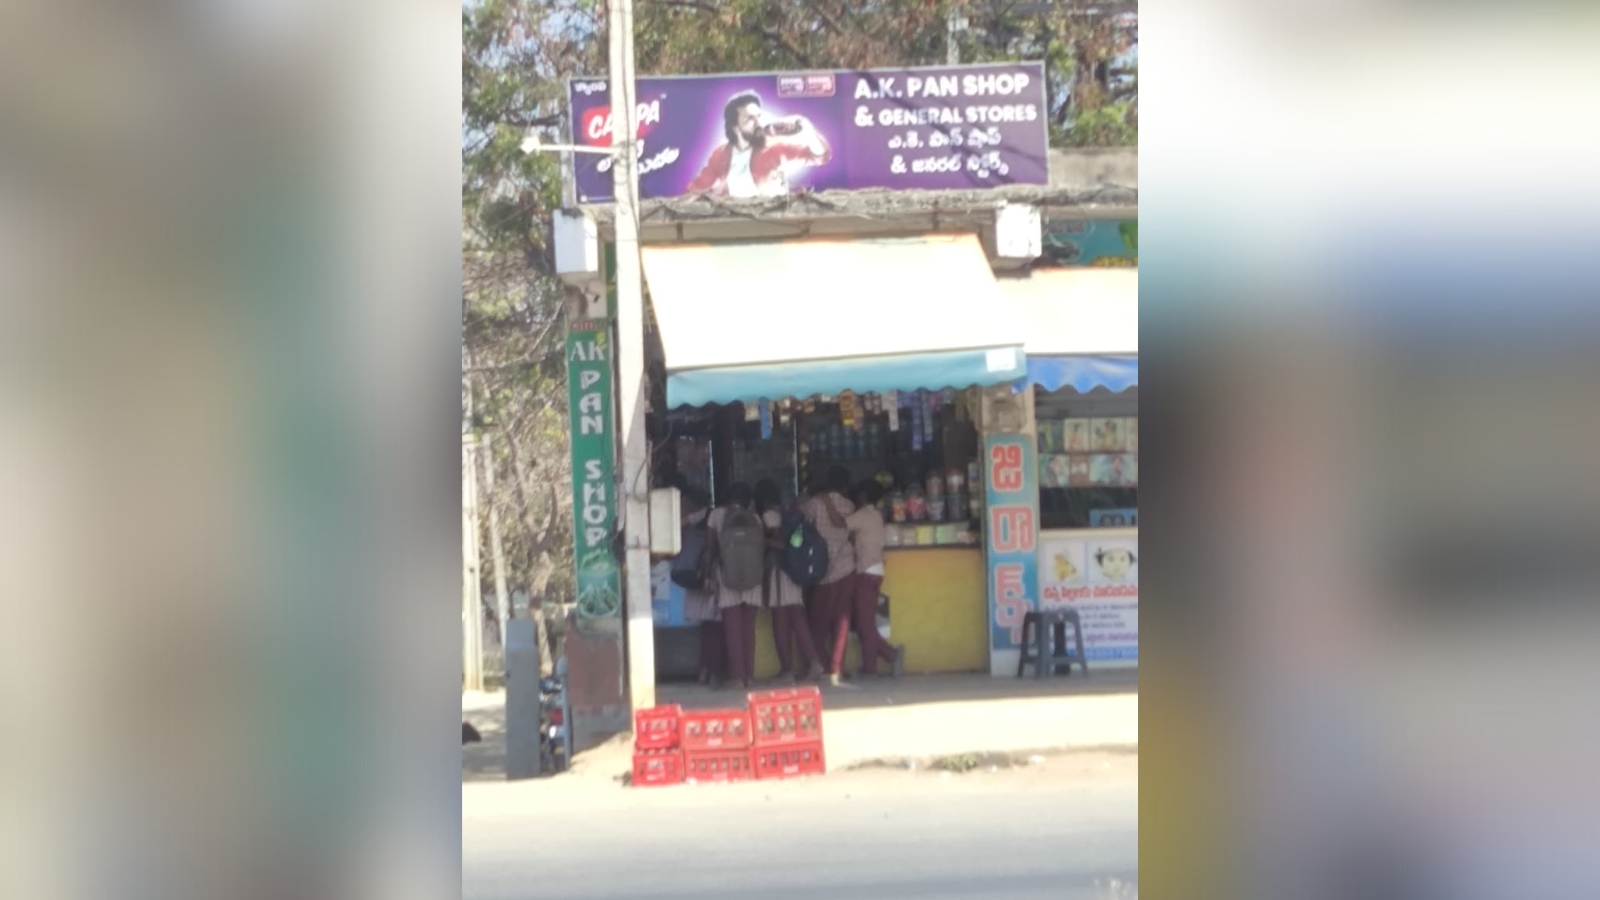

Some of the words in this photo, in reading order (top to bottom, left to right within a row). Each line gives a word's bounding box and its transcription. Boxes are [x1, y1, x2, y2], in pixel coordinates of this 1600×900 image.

[854, 77, 903, 99] A.K.
[906, 73, 959, 98] PAN
[962, 73, 1030, 95] SHOP
[588, 100, 660, 139] CAPA
[854, 105, 875, 126] &
[878, 107, 964, 126] GENERAL
[965, 104, 1037, 123] STORES
[890, 154, 907, 174] &
[569, 340, 605, 362] AK
[579, 370, 604, 435] PAN
[583, 459, 608, 547] SHOP
